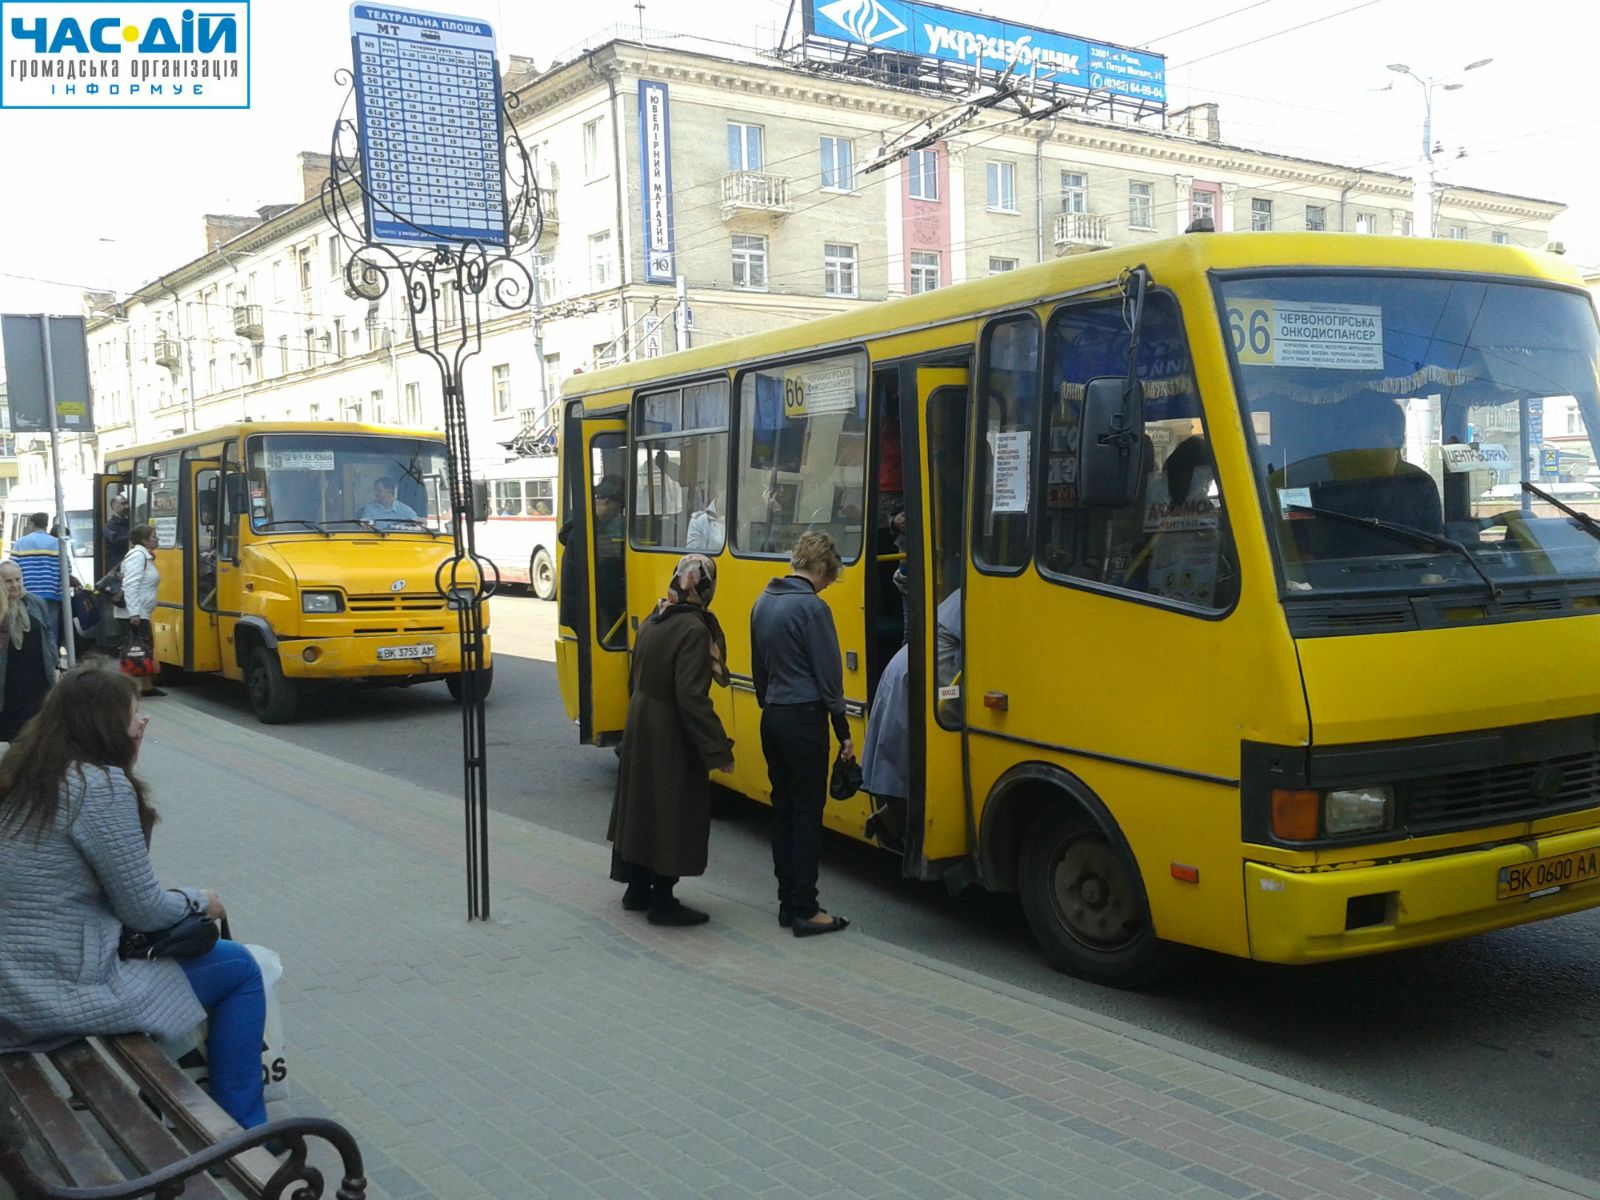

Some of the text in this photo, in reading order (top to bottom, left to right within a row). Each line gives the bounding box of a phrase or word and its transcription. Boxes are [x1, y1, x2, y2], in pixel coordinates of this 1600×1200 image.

[366, 9, 482, 35] ТЕАТРАЛЬНА ПЛОЩА
[376, 23, 400, 36] МТ
[365, 55, 376, 63] 53
[366, 65, 377, 74] 55
[367, 76, 378, 84] 56
[368, 87, 379, 95] 58
[369, 97, 379, 105] 61
[370, 118, 382, 126] 62
[371, 129, 383, 137] 63
[373, 150, 384, 158] 65
[373, 160, 385, 168] 66
[650, 95, 664, 246] ЮВЕЛІРНИЙ МАГАЗИН
[375, 171, 386, 179] 67
[376, 181, 387, 189] 69
[377, 192, 388, 200] 70
[1279, 312, 1376, 328] ЧЕРВОНОГІРСЬКА
[1226, 307, 1271, 356] 66
[1281, 326, 1377, 341] ОНКОДИСПАНСЕР
[786, 375, 804, 408] 66
[398, 646, 419, 658] 3755
[421, 645, 435, 656] AM
[1508, 852, 1598, 892] BK 0600 AA
